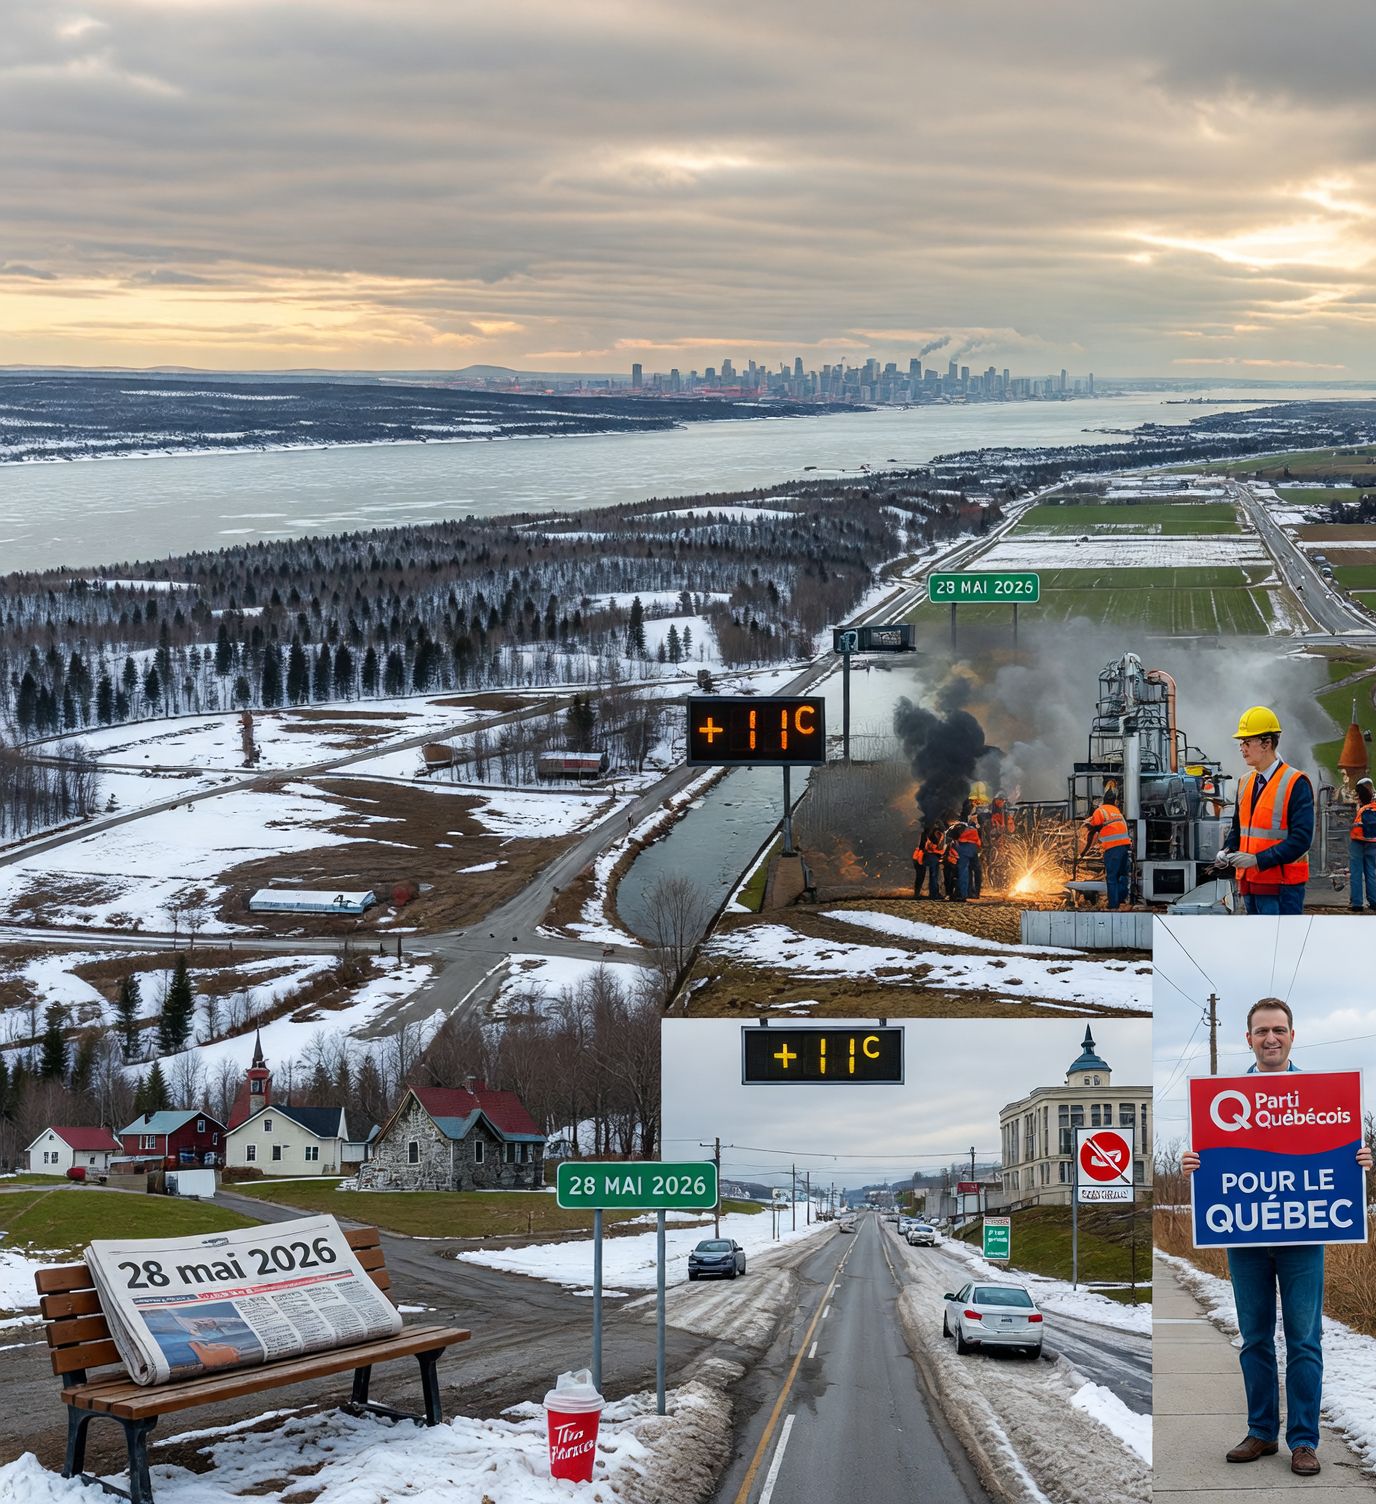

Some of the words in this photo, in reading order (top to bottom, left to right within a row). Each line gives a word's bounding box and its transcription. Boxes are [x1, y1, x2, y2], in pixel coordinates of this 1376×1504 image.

[936, 580, 955, 594] 28
[961, 580, 987, 594] MAI
[994, 580, 1033, 594] 2026
[1209, 1089, 1252, 1132] Q
[1255, 1090, 1300, 1109] Parti
[569, 1176, 596, 1195] 28
[604, 1176, 642, 1195] MAI
[652, 1176, 706, 1195] 2026
[1222, 1170, 1296, 1194] POUR
[1303, 1169, 1335, 1191] LE
[1205, 1194, 1354, 1233] QUÉBEC
[118, 1260, 170, 1289] 28
[176, 1252, 247, 1285] mai
[247, 1237, 337, 1275] 2026
